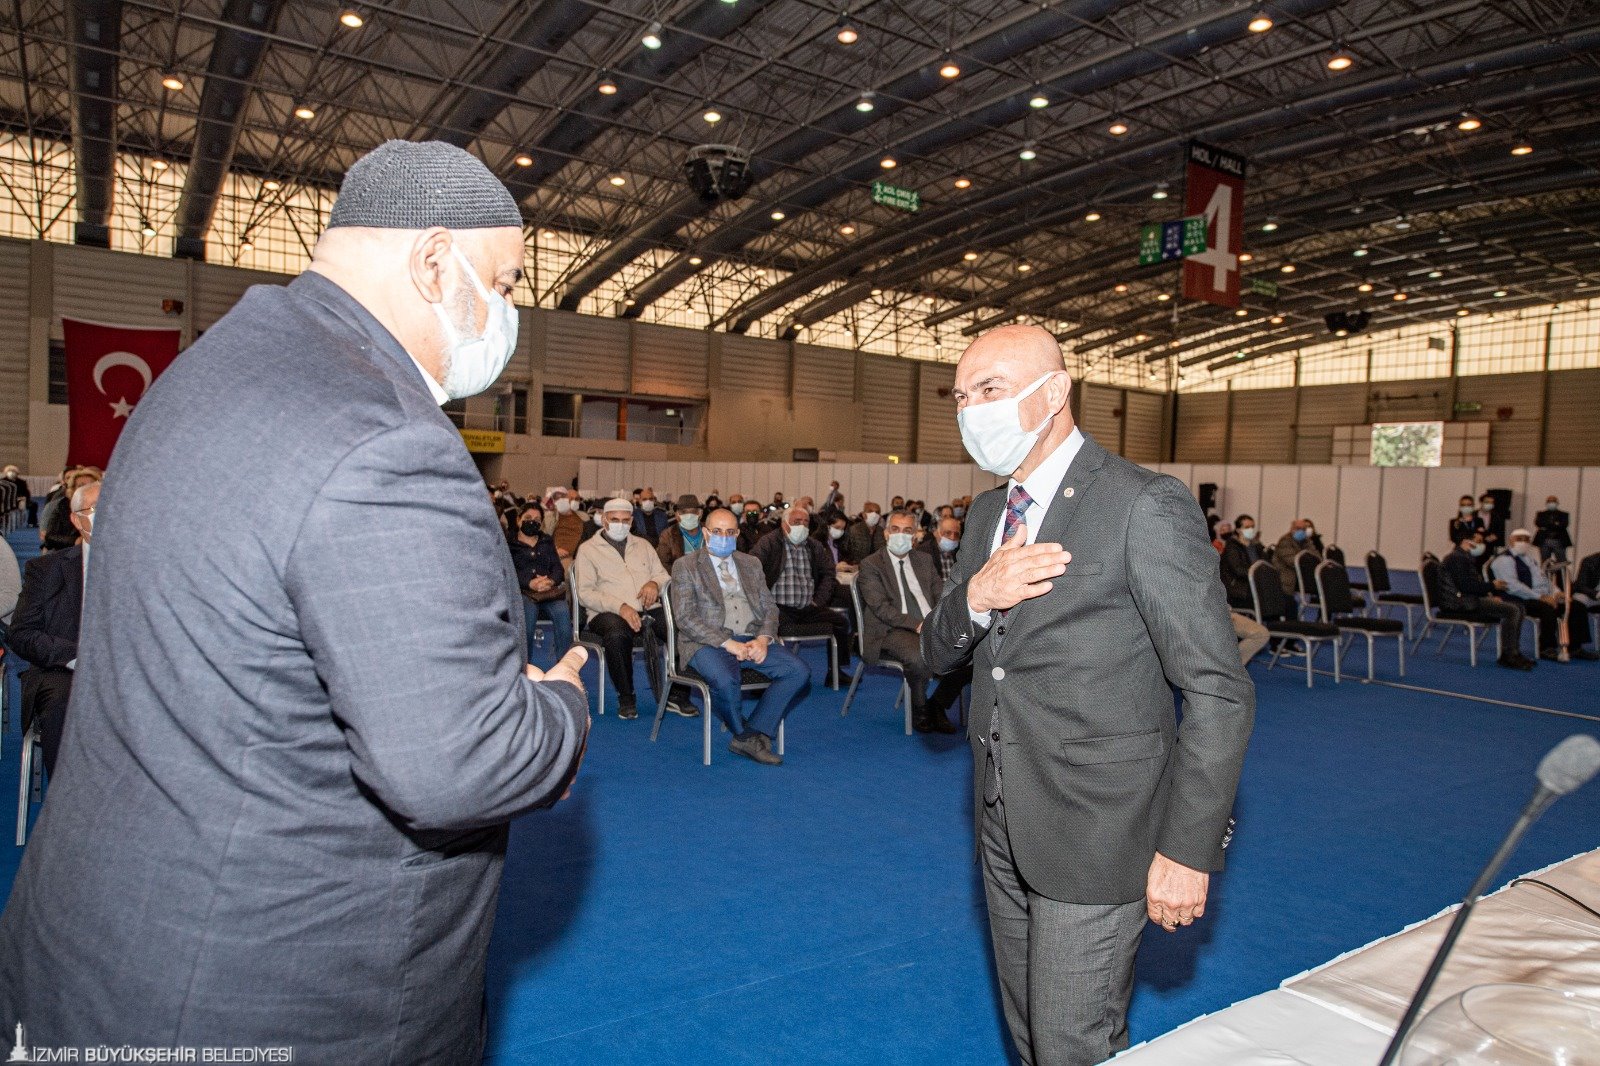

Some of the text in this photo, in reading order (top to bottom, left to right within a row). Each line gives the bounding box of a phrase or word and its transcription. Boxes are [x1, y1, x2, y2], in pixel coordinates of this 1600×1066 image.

[1191, 145, 1212, 164] HOL
[1219, 155, 1242, 175] HALL
[1186, 183, 1238, 293] 4
